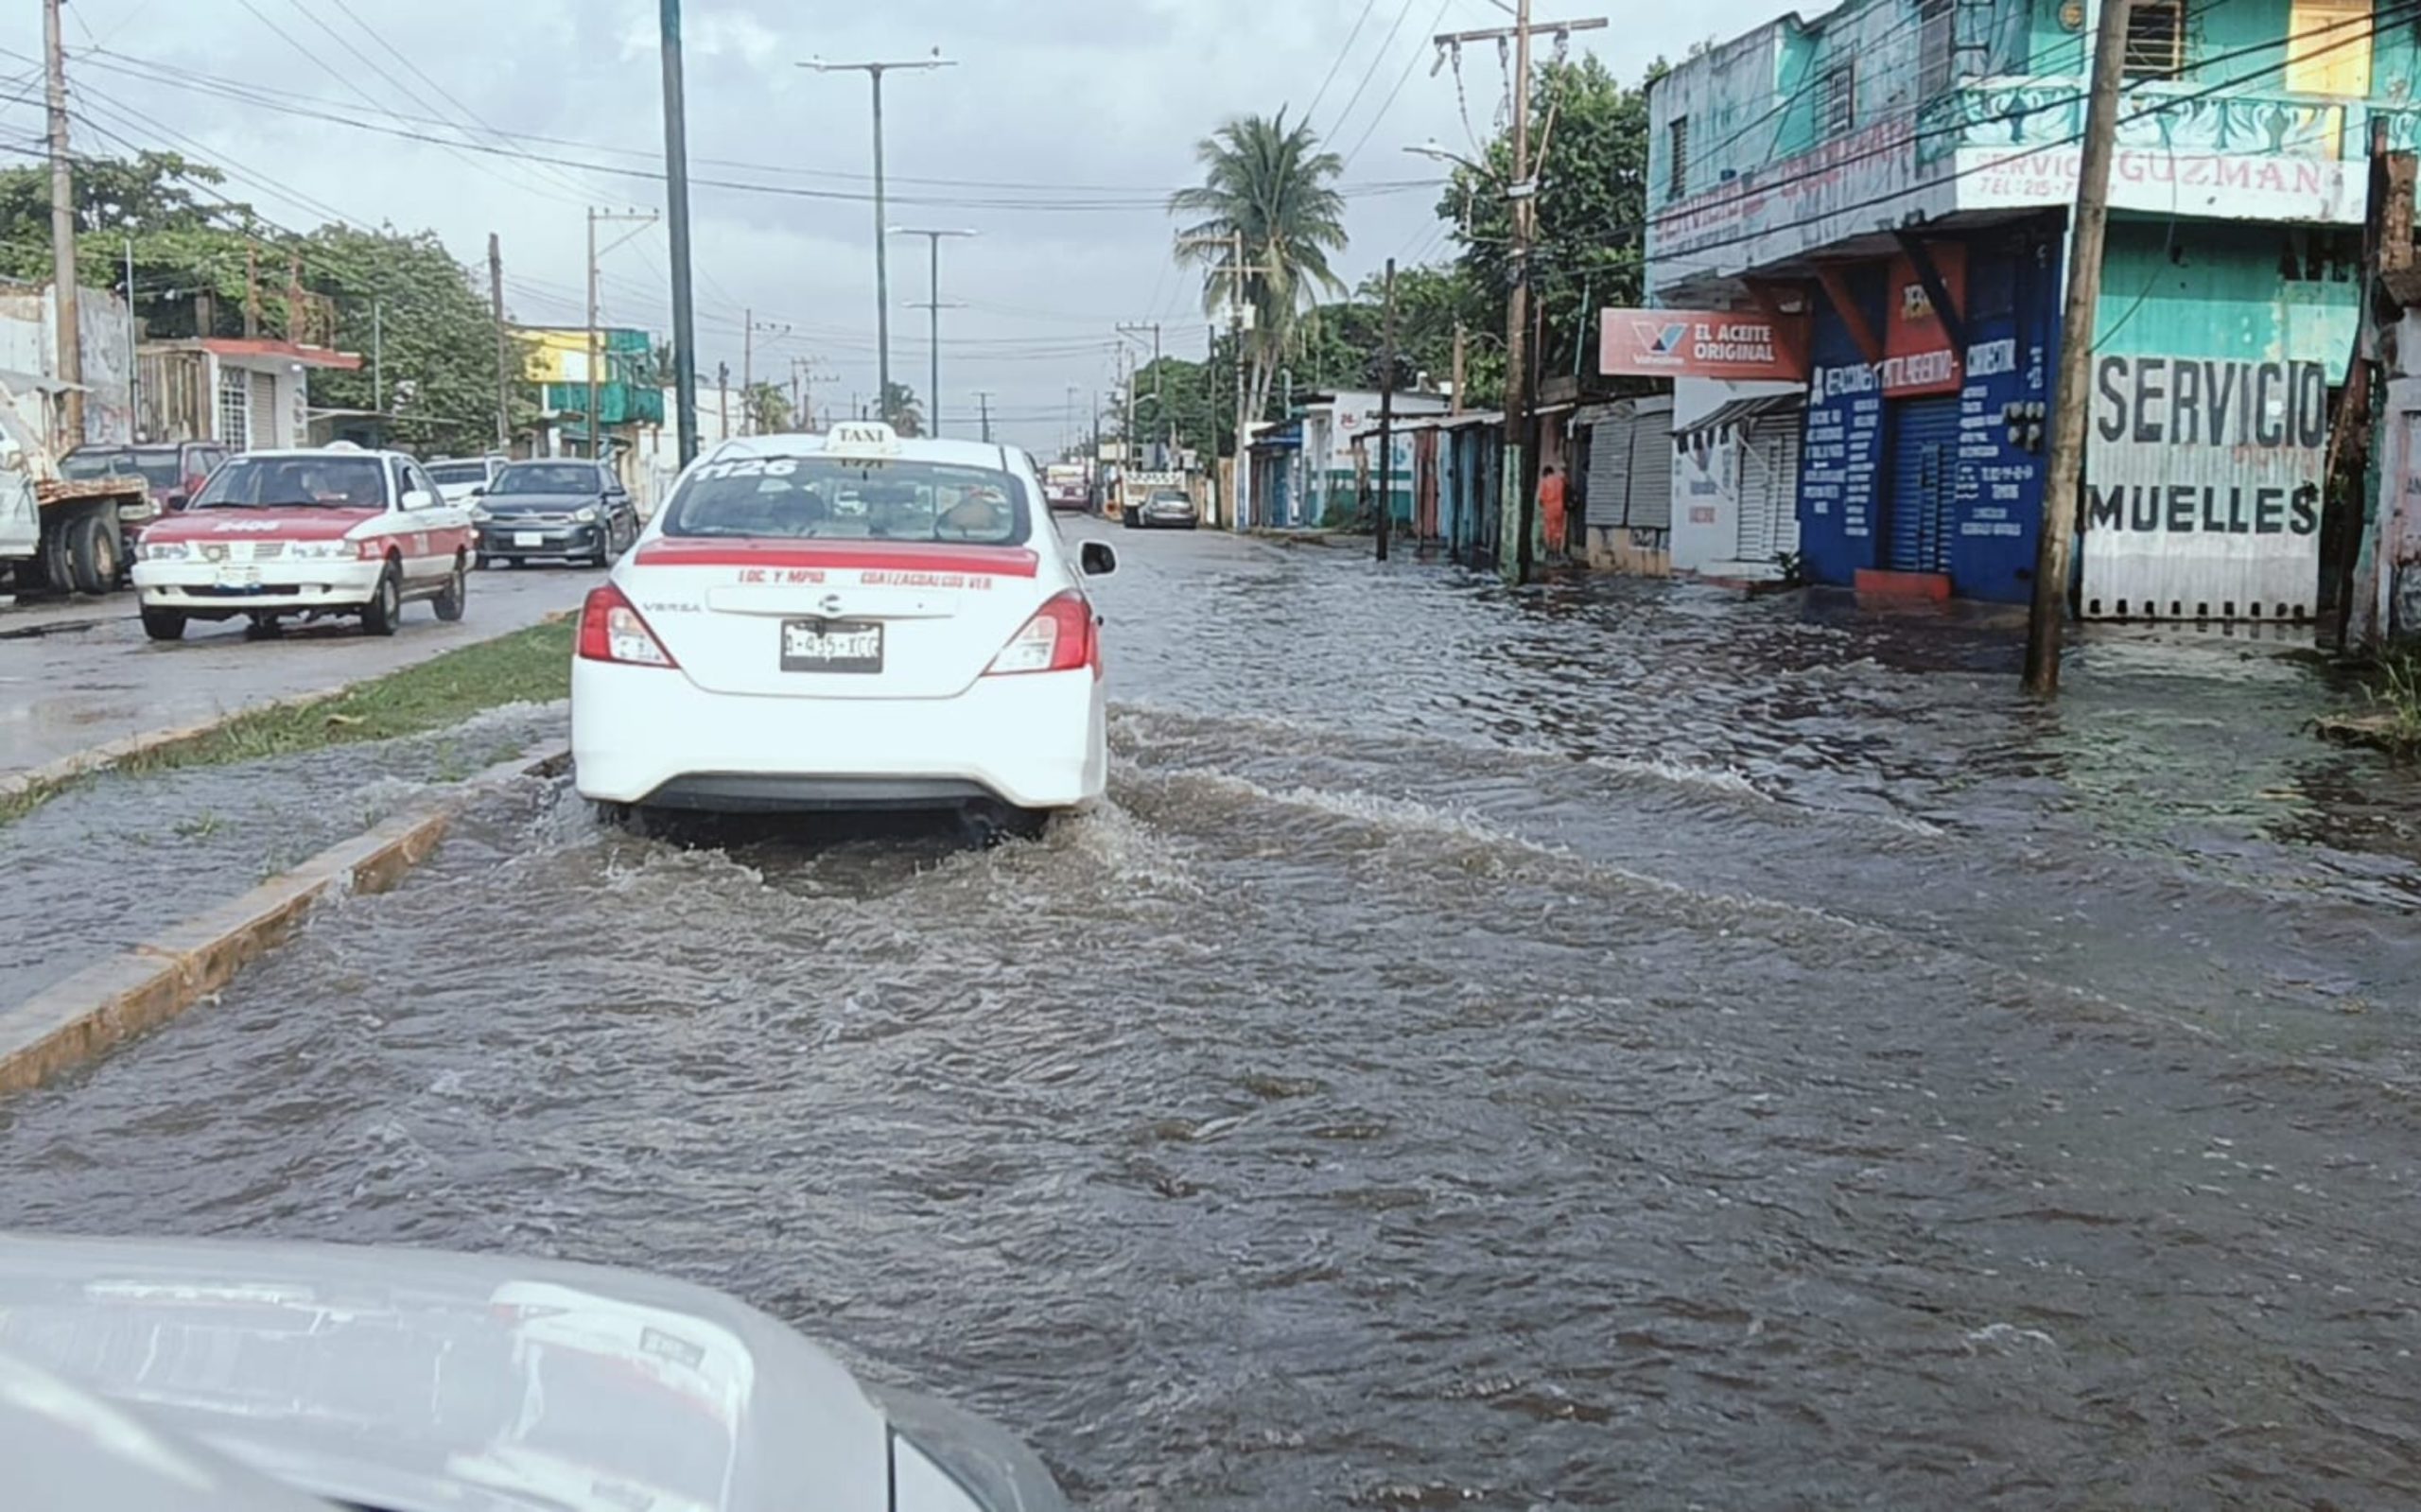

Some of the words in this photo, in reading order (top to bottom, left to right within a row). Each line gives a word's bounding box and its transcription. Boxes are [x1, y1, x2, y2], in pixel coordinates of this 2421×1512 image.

[2118, 148, 2321, 195] GUZMAN
[1695, 323, 1713, 341] EL
[1717, 324, 1771, 342] ACEITE
[1694, 341, 1775, 362] ORIGINAL
[2098, 356, 2325, 448] SERVICIO
[839, 427, 885, 443] TAXI
[2086, 482, 2320, 535] MUELLES
[643, 602, 702, 615] VERSA
